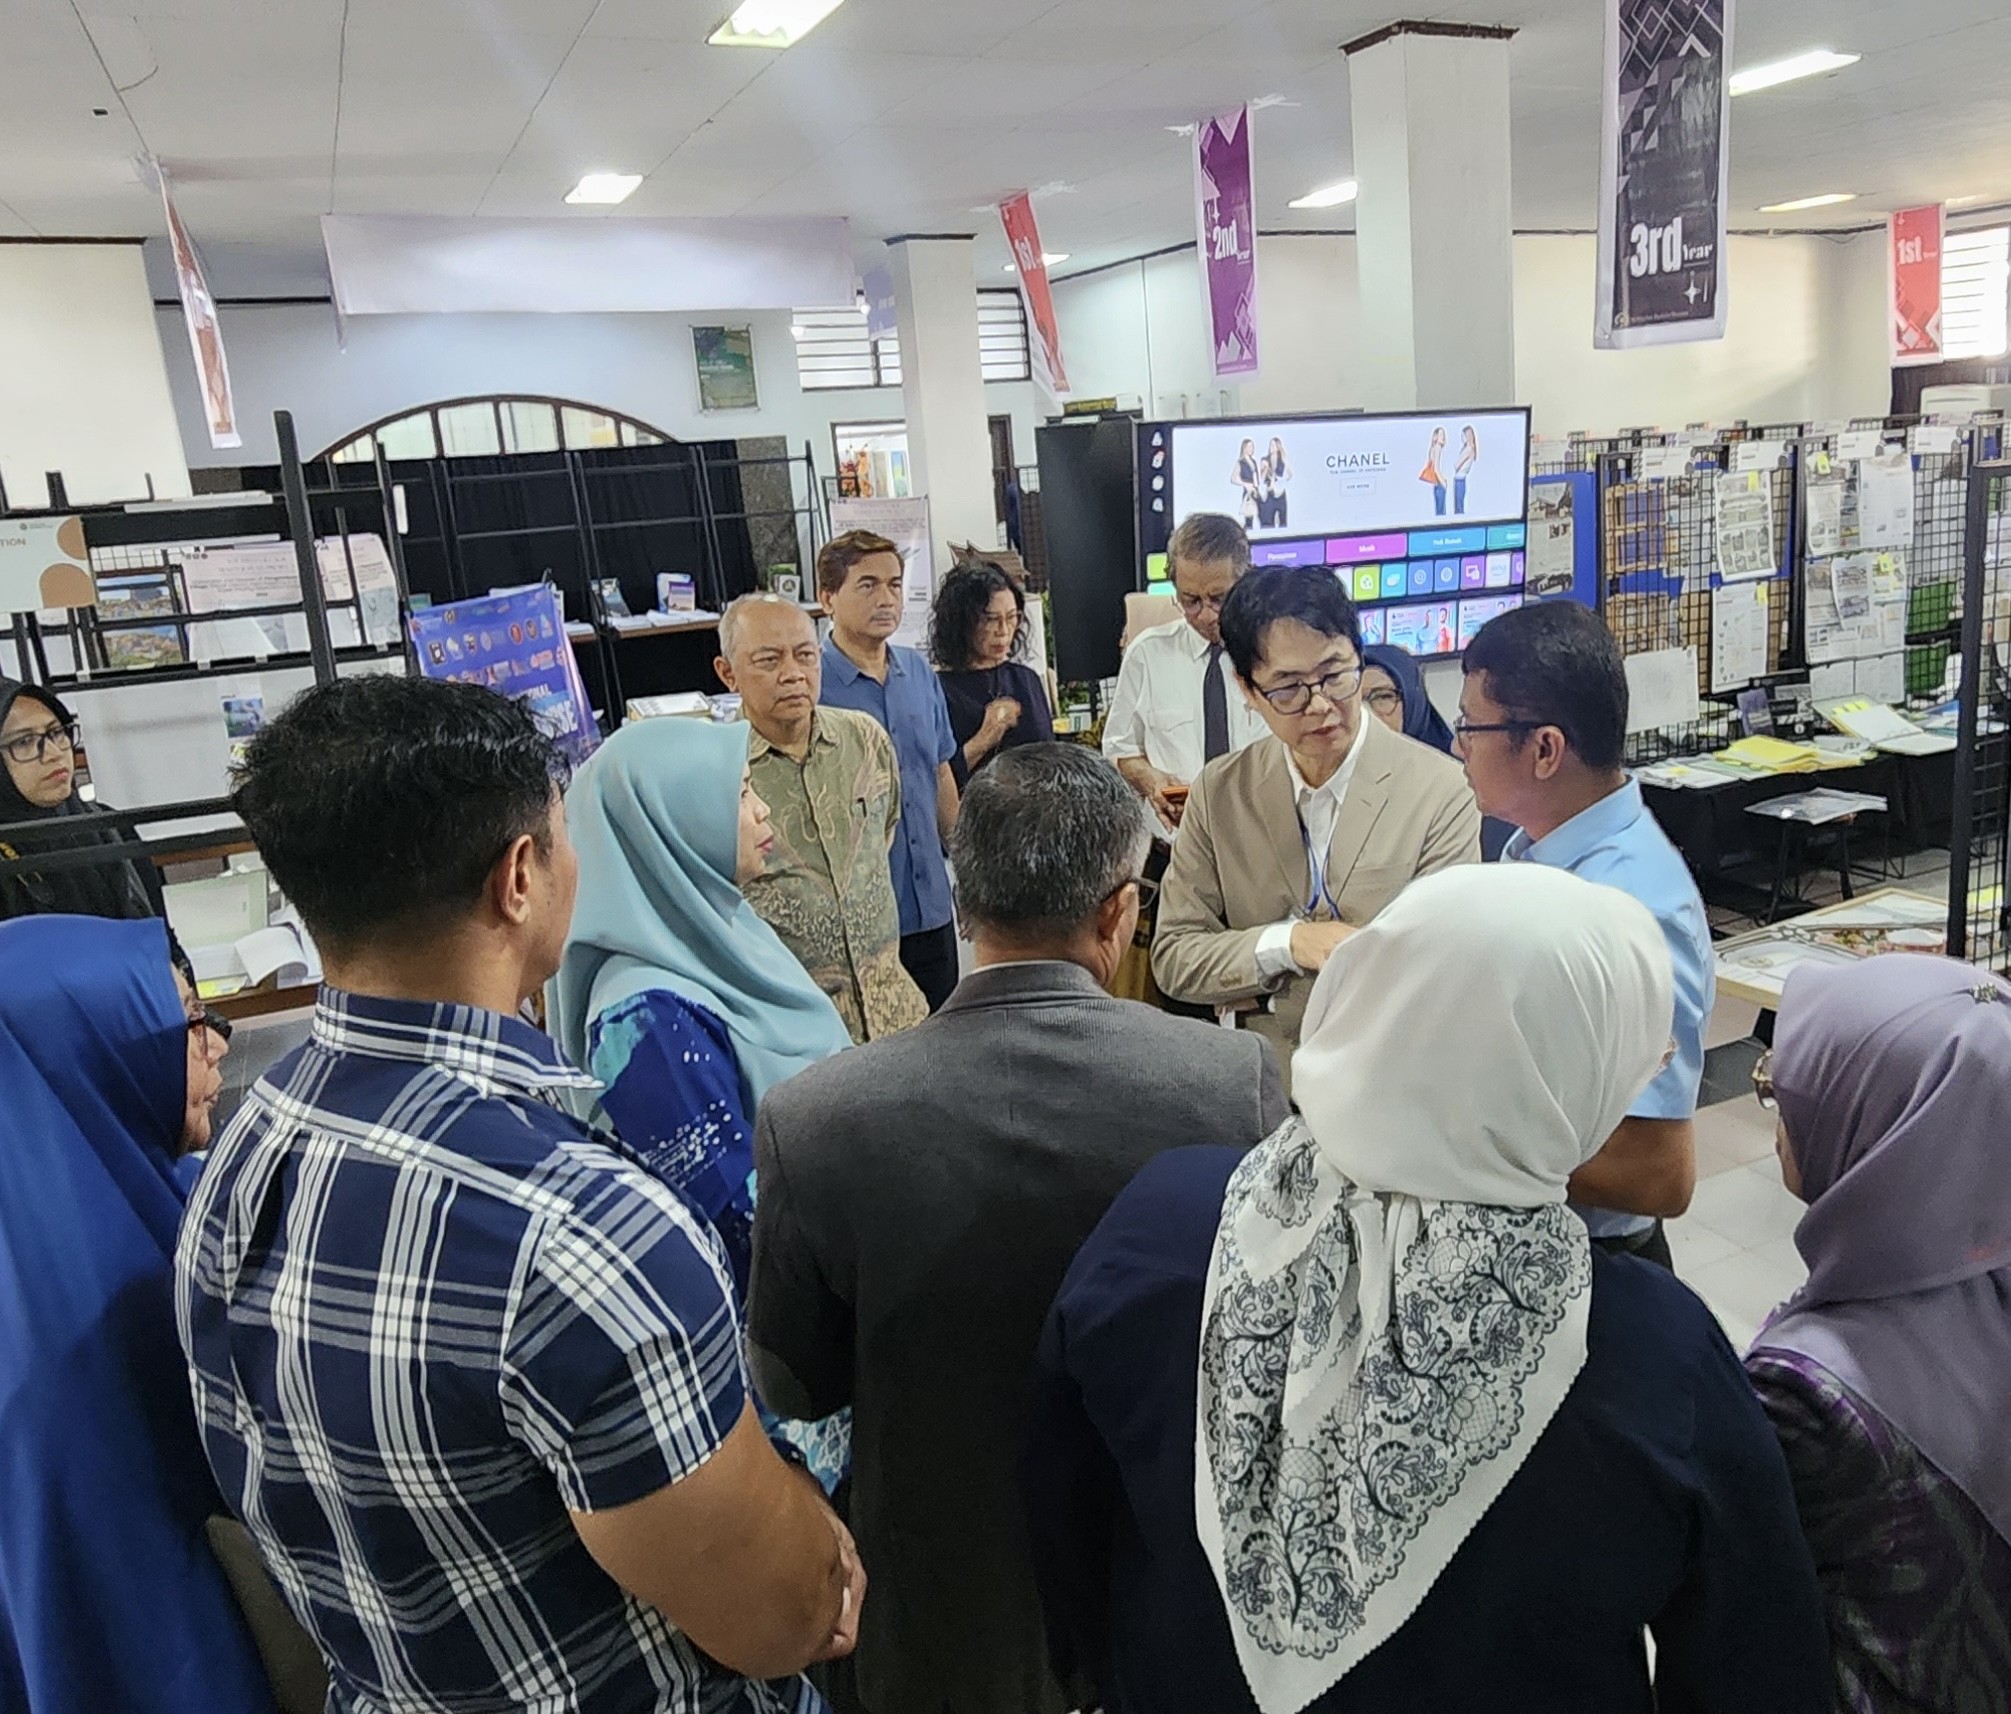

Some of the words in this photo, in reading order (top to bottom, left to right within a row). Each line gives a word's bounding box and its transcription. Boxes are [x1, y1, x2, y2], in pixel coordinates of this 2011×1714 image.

[1015, 236, 1037, 272] 1st
[1212, 219, 1238, 261] 2nd
[1629, 216, 1682, 278] 3rd
[1897, 235, 1922, 265] 1st
[1326, 452, 1390, 469] CHANEL
